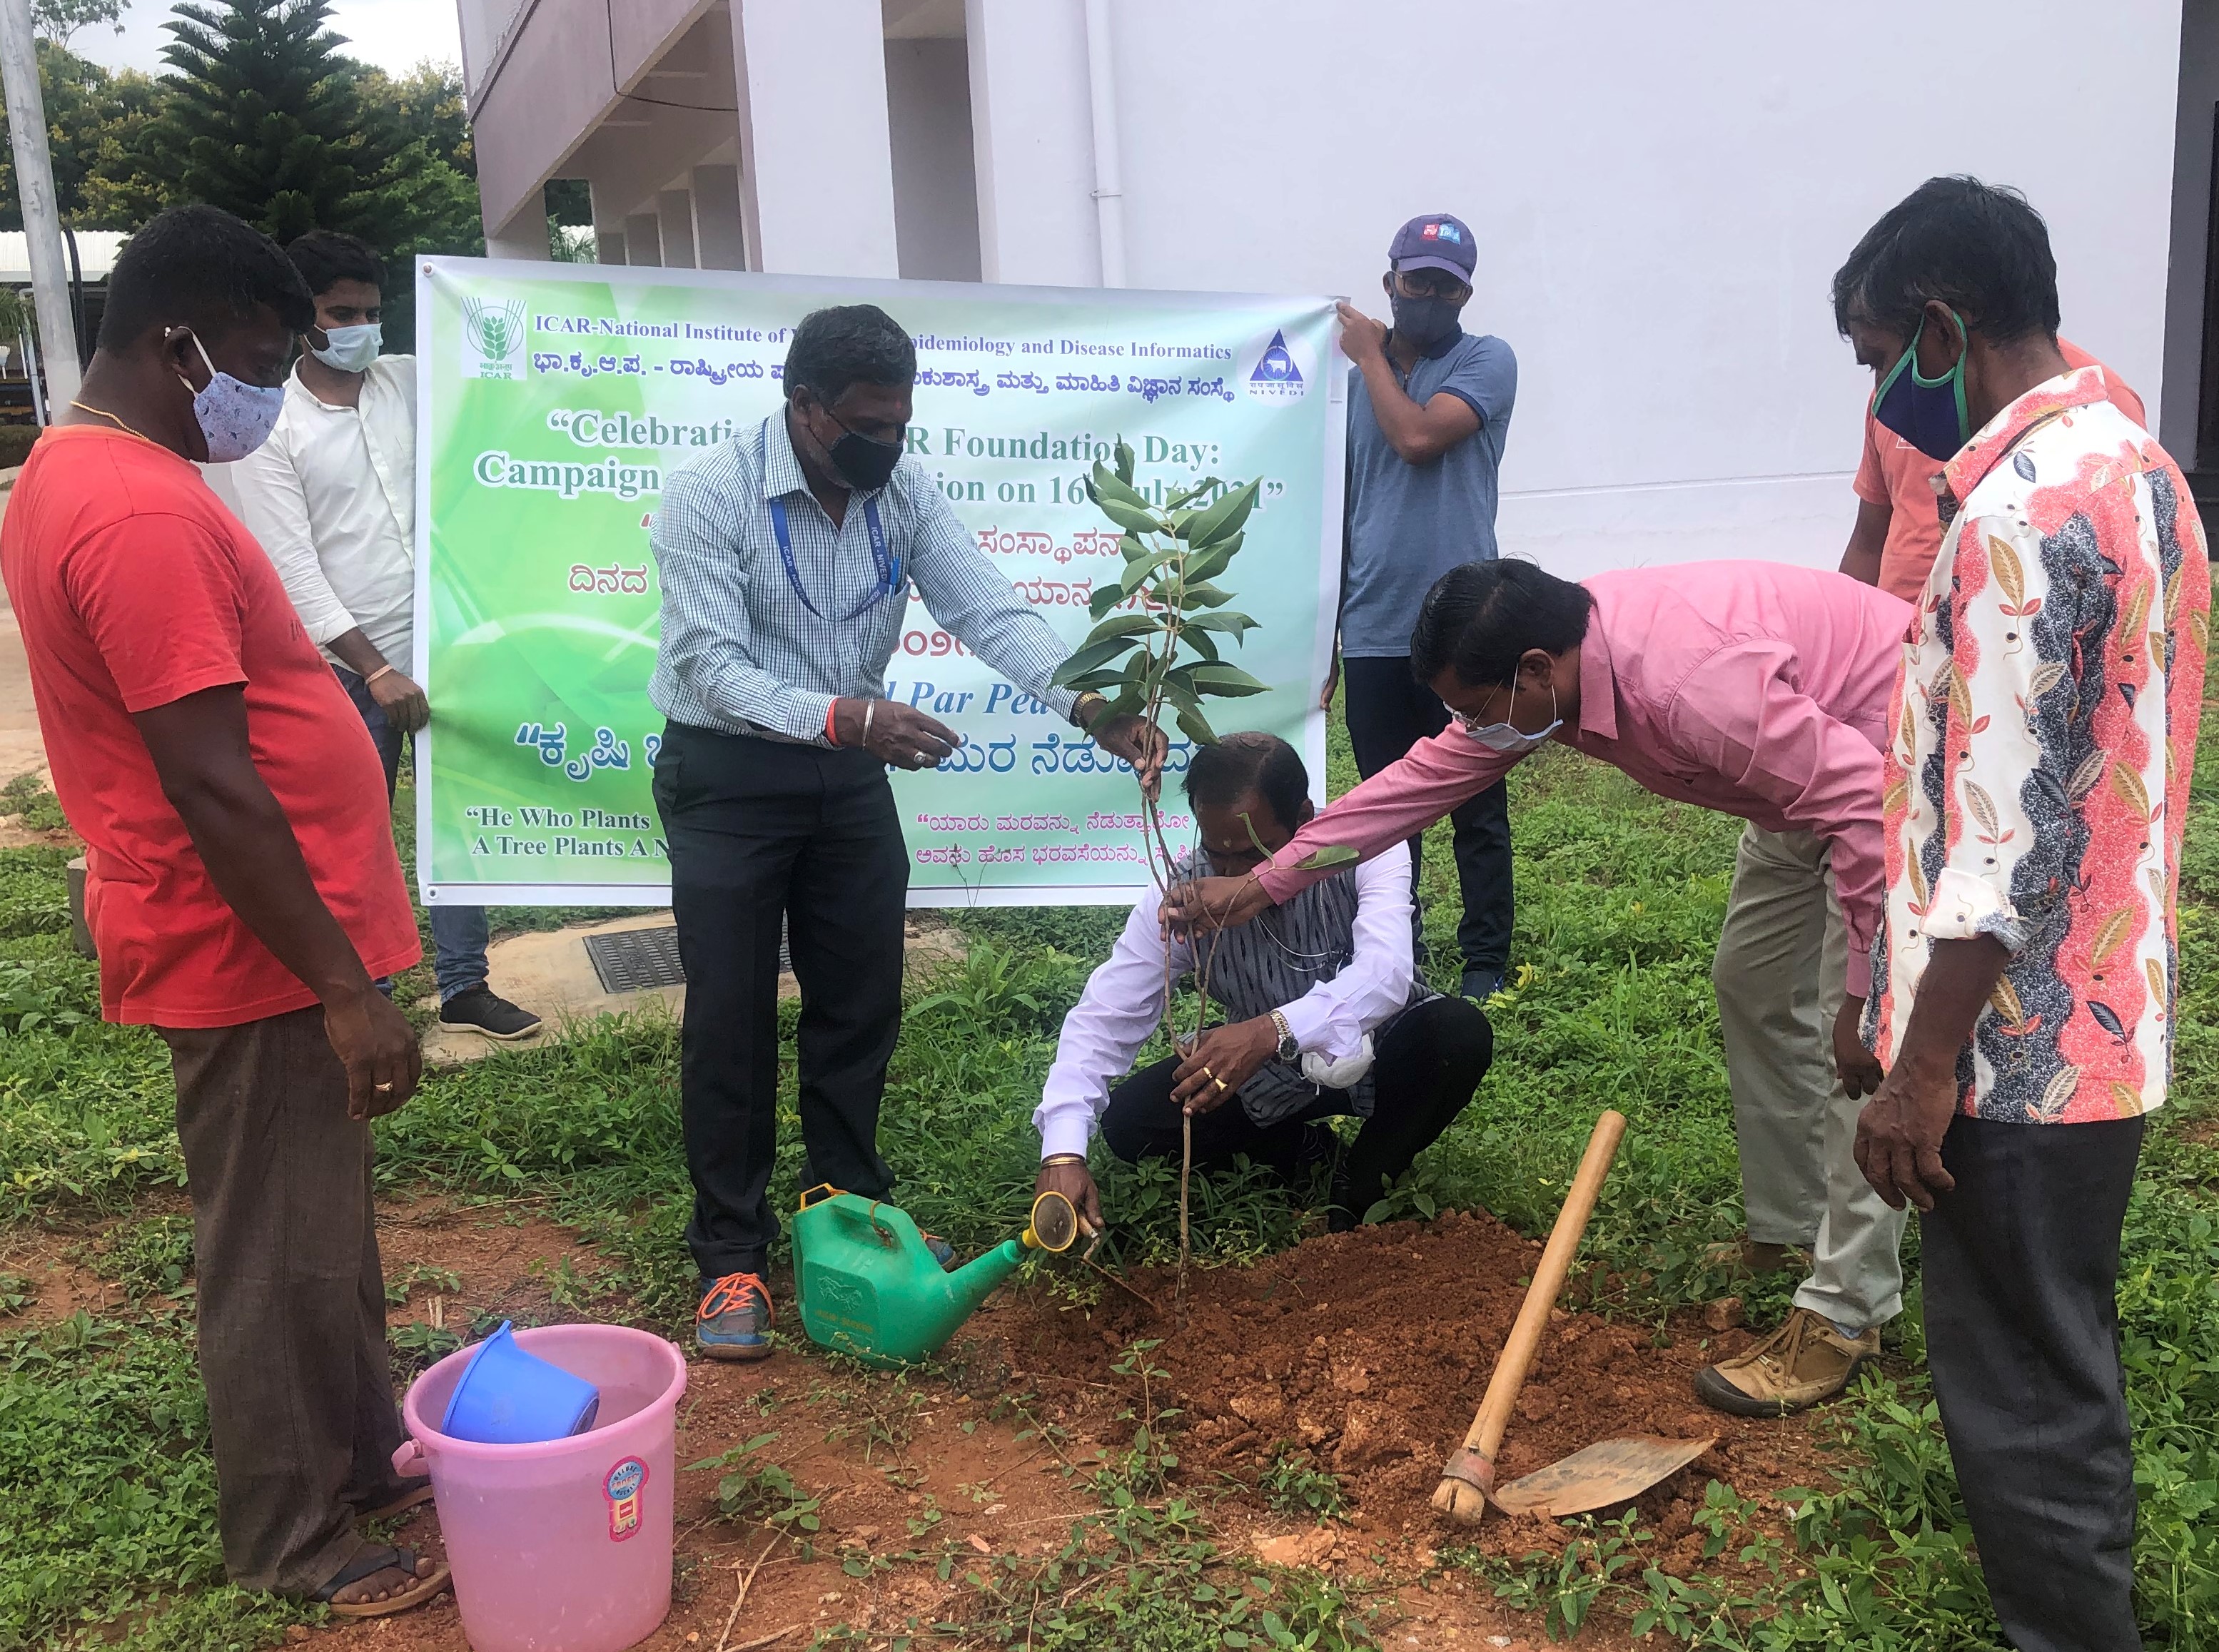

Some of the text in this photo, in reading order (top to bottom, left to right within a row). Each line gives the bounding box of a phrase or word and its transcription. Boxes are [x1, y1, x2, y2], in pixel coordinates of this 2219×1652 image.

[536, 315, 678, 338] ICAR-National
[685, 323, 762, 343] Institute
[768, 328, 787, 343] of
[911, 334, 1016, 357] pidemiology
[1021, 340, 1054, 354] and
[1060, 340, 1125, 356] Disease
[1131, 342, 1231, 360] Informatics
[670, 358, 764, 385] ರಾಷ್ಟ್ರೀಯ
[997, 370, 1050, 394] ಮತ್ತು
[1056, 373, 1120, 392] ಮಾಹಿತಿ
[1127, 375, 1182, 403] ವಿಜ್ಞಾನ
[1188, 377, 1235, 403] ಸಂಸ್ಥೆ
[551, 413, 1218, 472] “Celebrati R Foundatio Day:
[477, 454, 661, 497] Campaign
[935, 472, 986, 501] ion
[998, 482, 1036, 503] on
[871, 527, 881, 551] ICAR
[876, 554, 888, 582] NIVEDI
[978, 525, 1125, 564] ಸಂಸ್ಥಾಪನ
[570, 564, 647, 594] ದಿನದ
[1014, 576, 1092, 607] ಯಾನ
[783, 545, 793, 568] ICAR
[792, 574, 807, 601] NIVEDI
[910, 681, 974, 713] Par
[466, 807, 650, 829] “He Who Plants
[917, 813, 989, 831] “ಯಾರು
[472, 836, 669, 856] A Tree Plants A N
